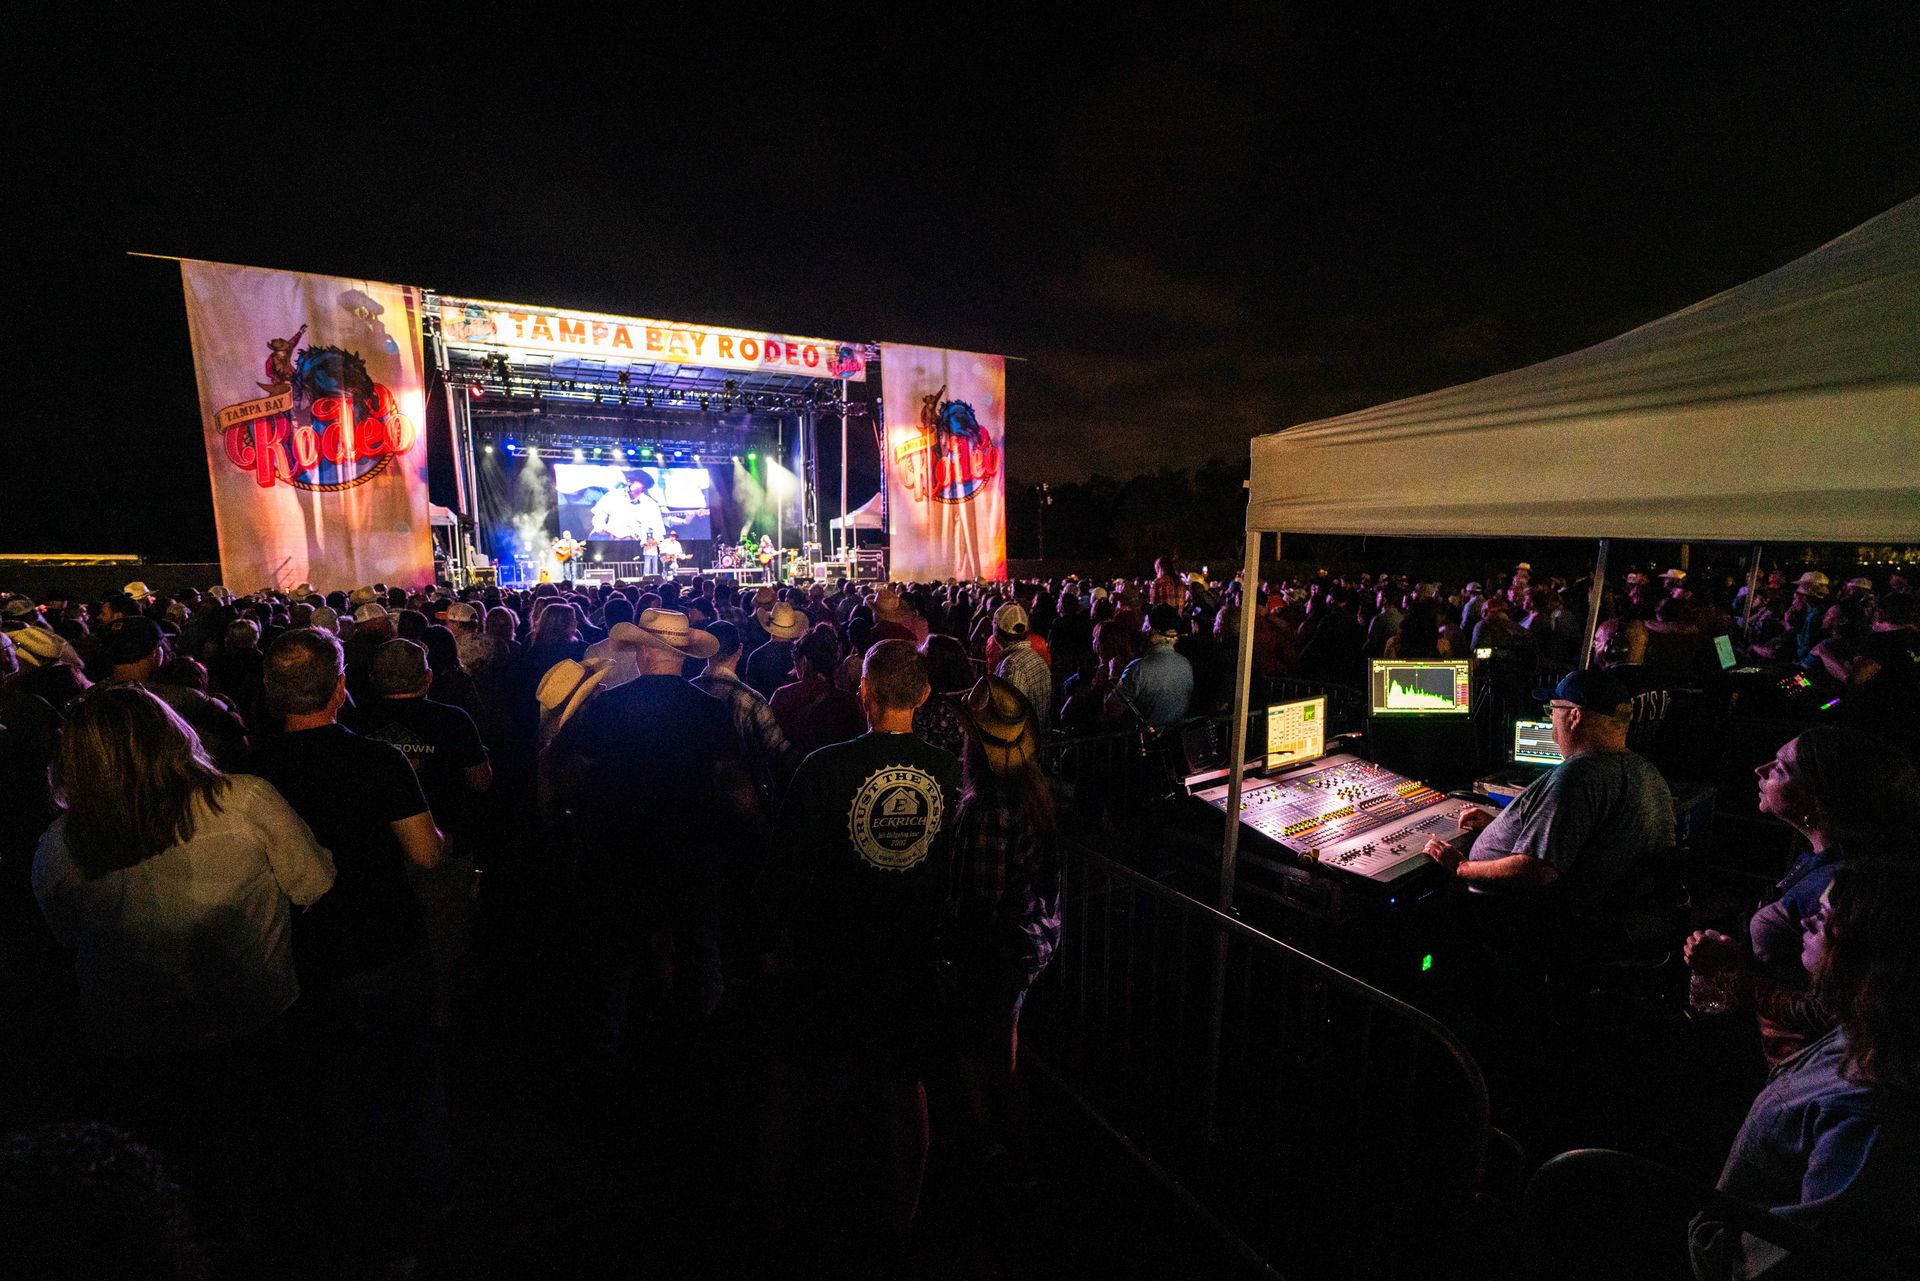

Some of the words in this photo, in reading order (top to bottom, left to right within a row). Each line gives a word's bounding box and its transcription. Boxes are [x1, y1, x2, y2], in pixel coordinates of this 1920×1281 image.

[508, 311, 633, 349] TAMPA
[646, 325, 706, 356] BAY
[718, 335, 820, 368] RODEO
[225, 404, 261, 422] TAMPA
[265, 398, 283, 412] BAY
[223, 383, 416, 488] Rodeo
[856, 782, 879, 847] TRUST
[882, 772, 922, 785] THE
[872, 816, 926, 829] ECKRICH
[892, 798, 908, 813] E
